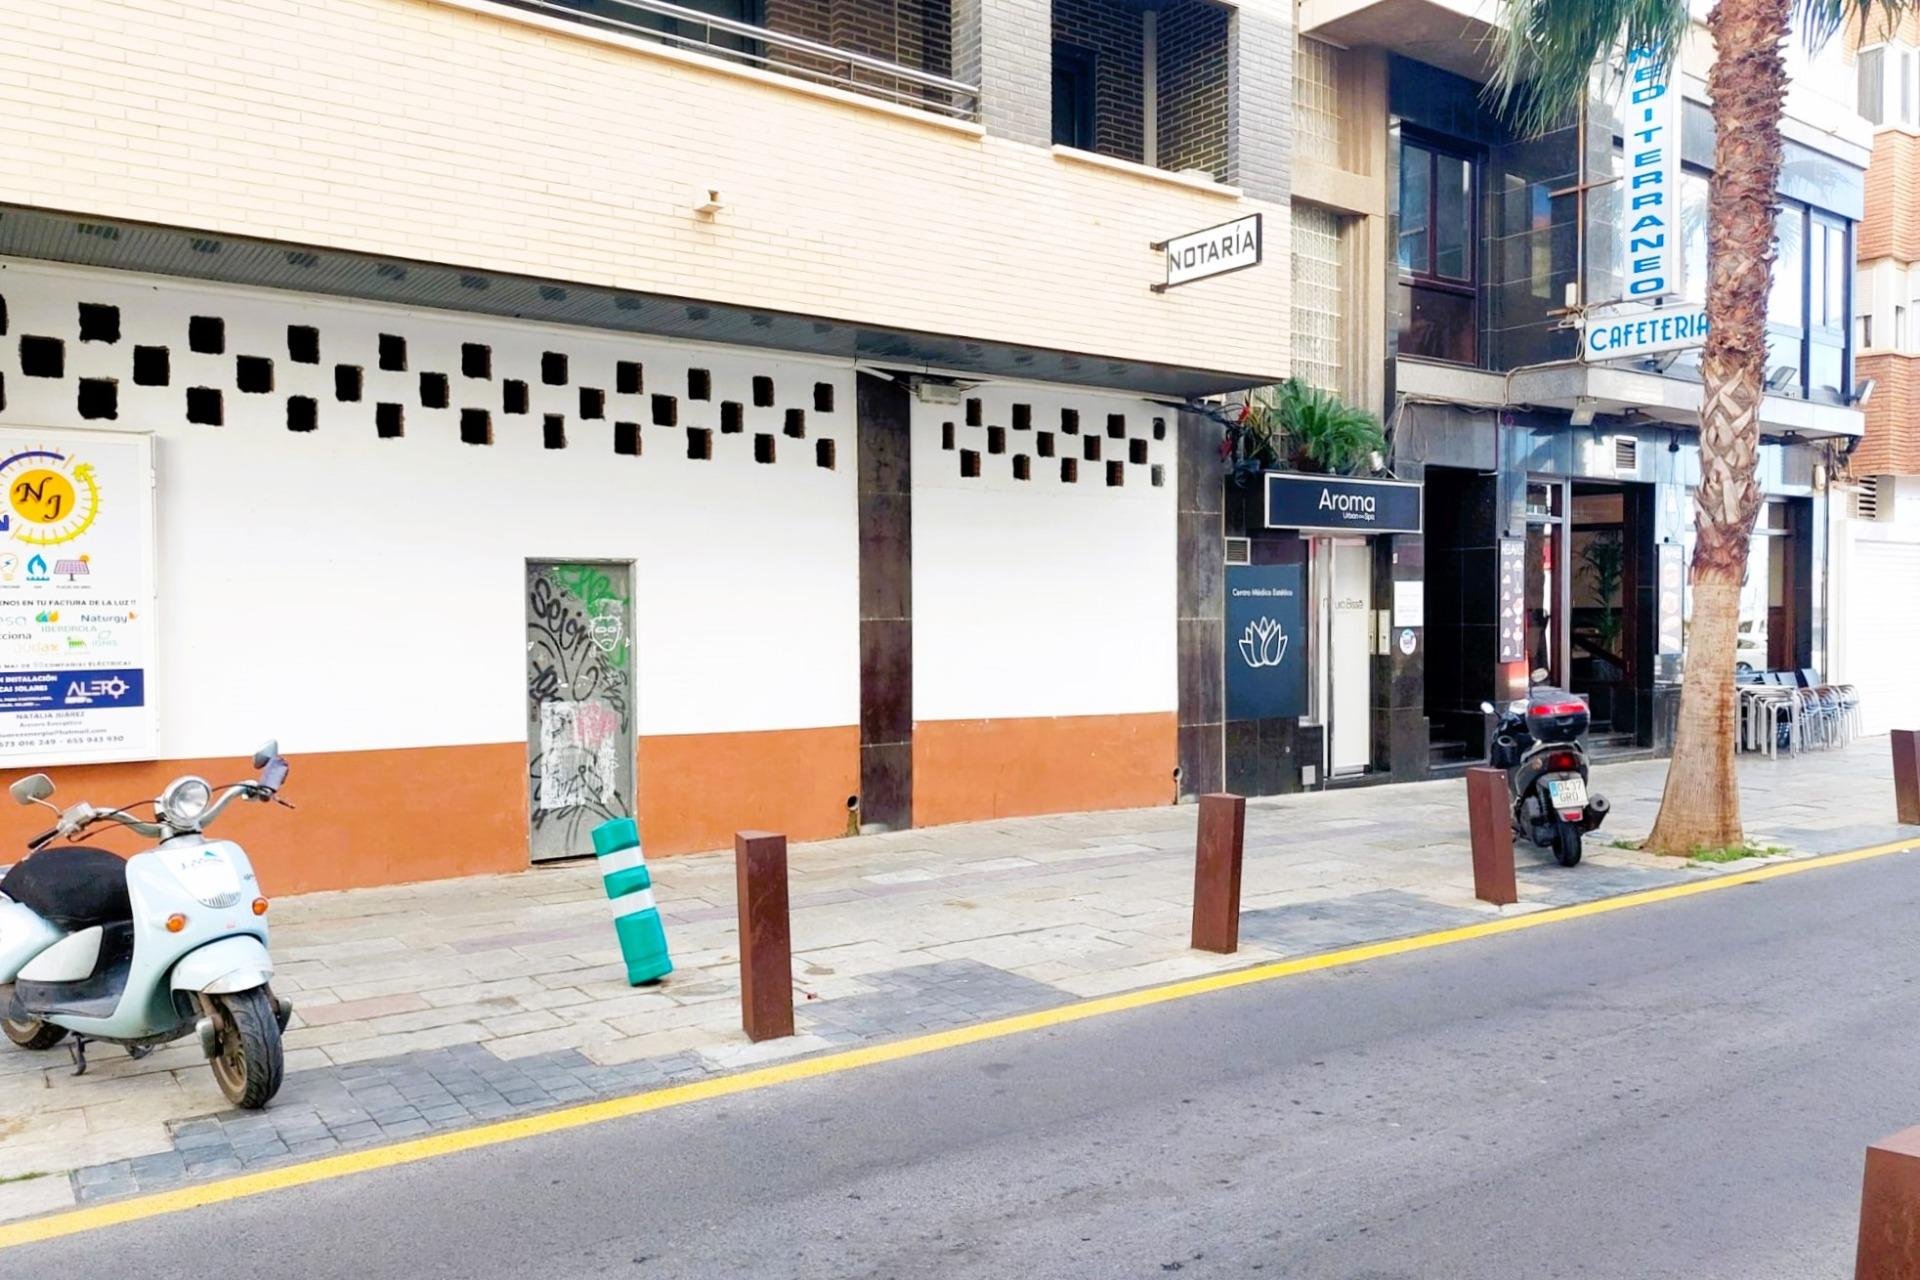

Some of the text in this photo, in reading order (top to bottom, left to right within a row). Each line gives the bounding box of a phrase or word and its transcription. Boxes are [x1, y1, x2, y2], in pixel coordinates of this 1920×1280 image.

[1169, 224, 1255, 272] NOTARÍA
[1590, 313, 1709, 351] CAFETERIA
[1319, 487, 1376, 512] Aroma
[1342, 511, 1359, 520] Urban
[1364, 512, 1376, 522] Spa
[1232, 586, 1294, 597] Centro Médico Estético
[81, 614, 128, 624] Naturgy
[41, 625, 97, 633] IBERDROLA
